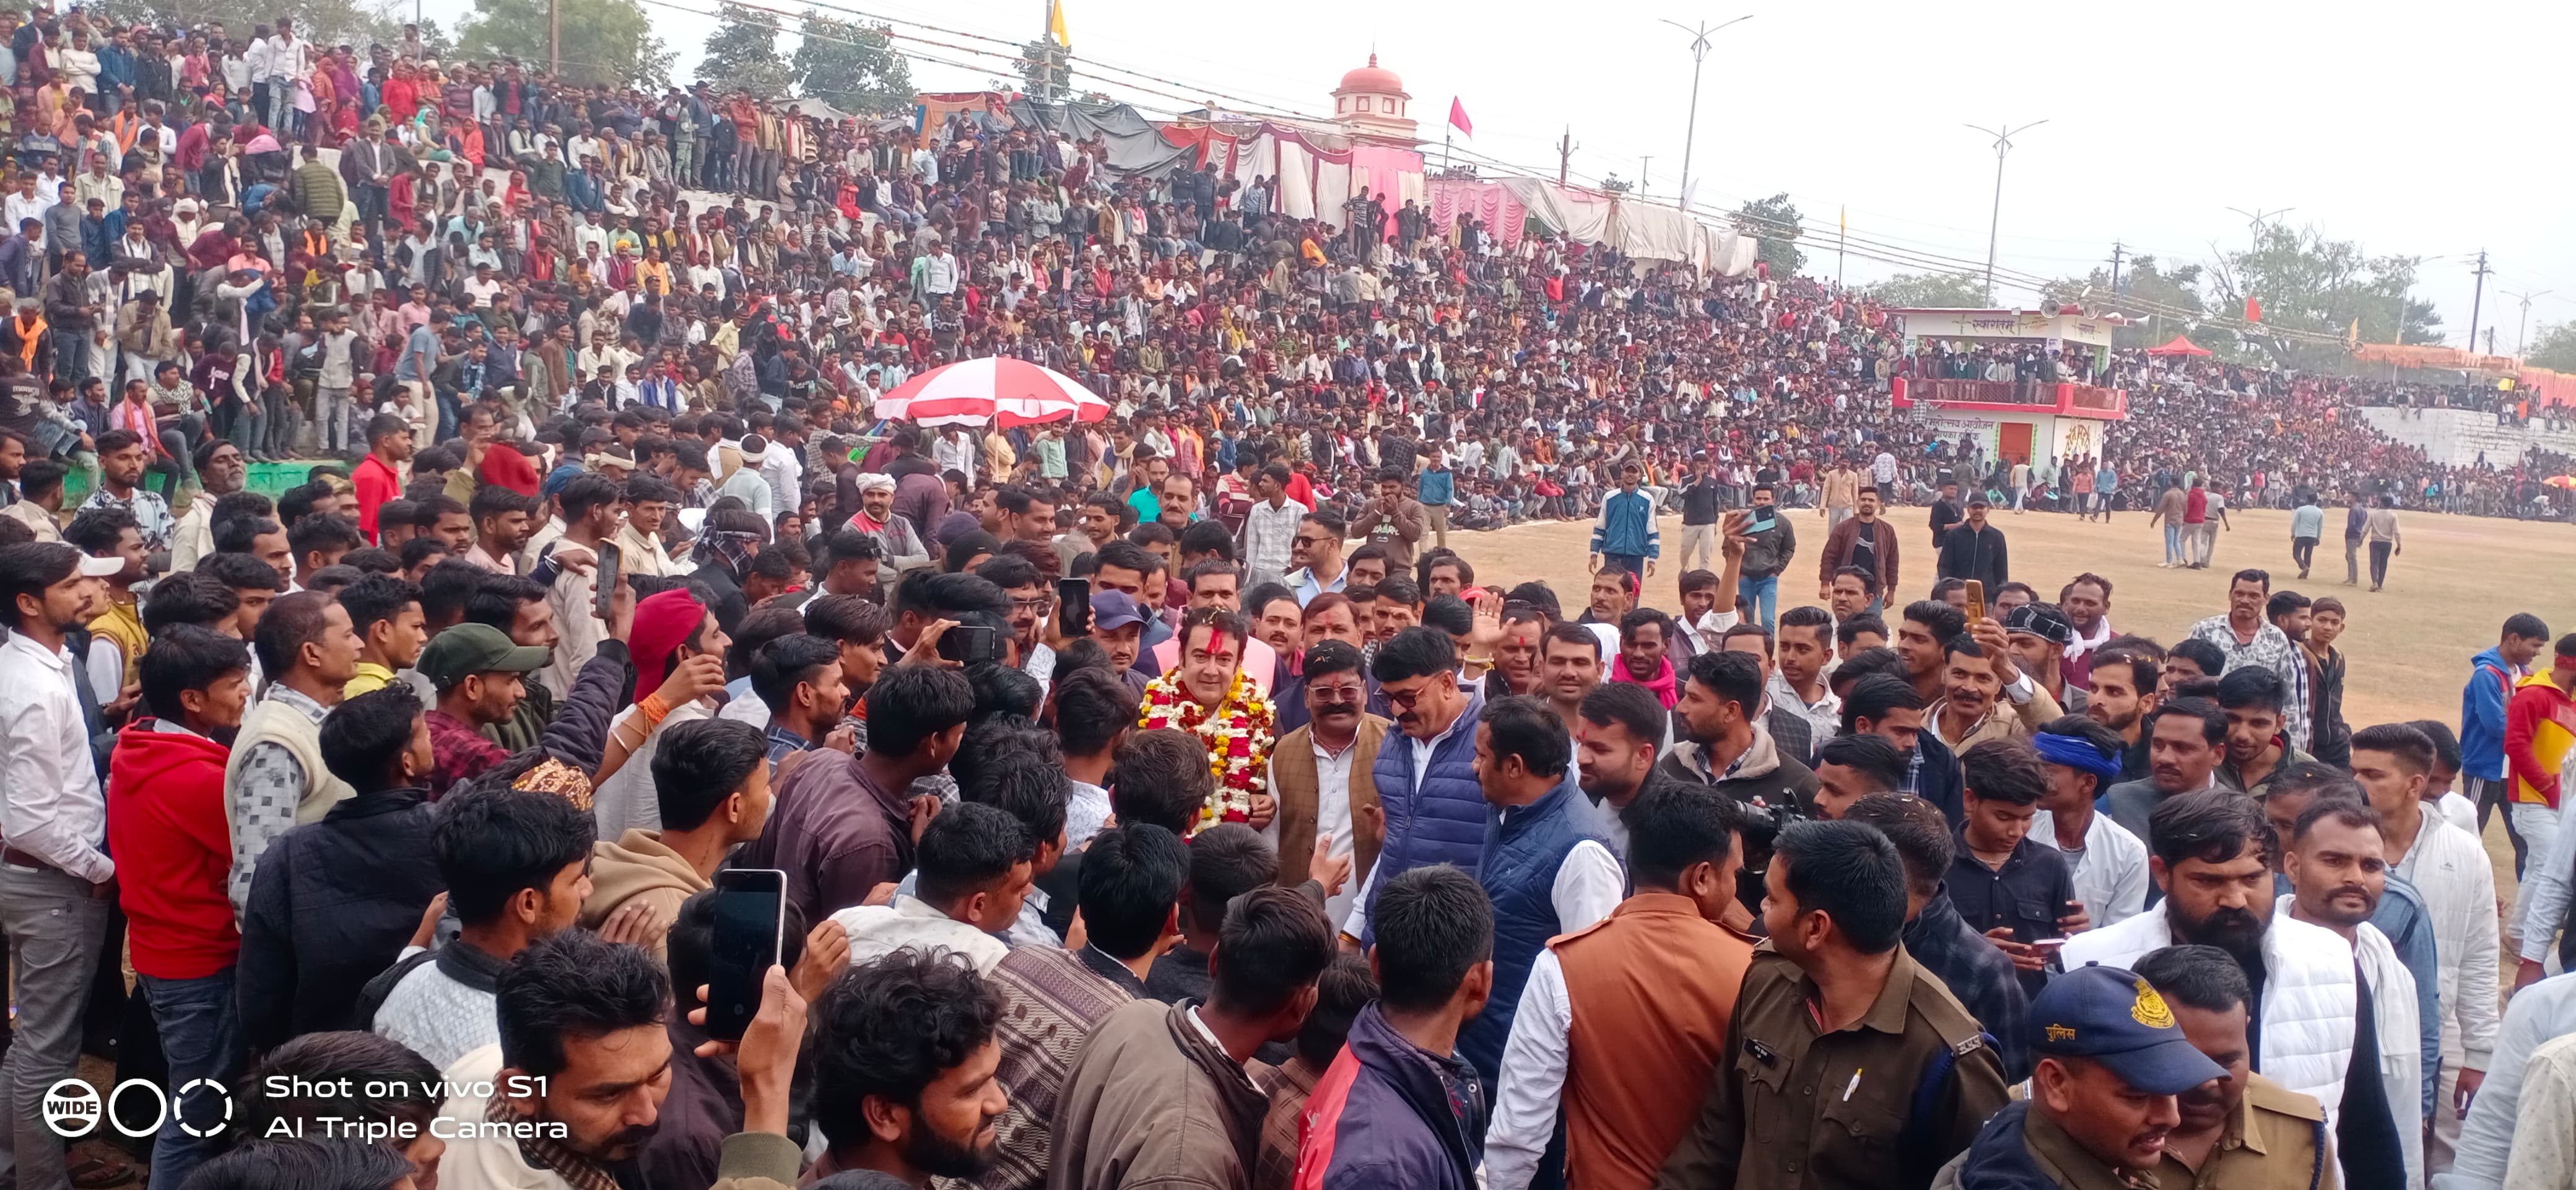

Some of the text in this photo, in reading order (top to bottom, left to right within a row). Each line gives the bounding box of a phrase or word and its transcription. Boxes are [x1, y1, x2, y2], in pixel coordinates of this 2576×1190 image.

[1973, 319, 2015, 335] स्वागतम्
[1961, 417, 1995, 429] आयोजन
[2045, 1023, 2076, 1042] पुलिस
